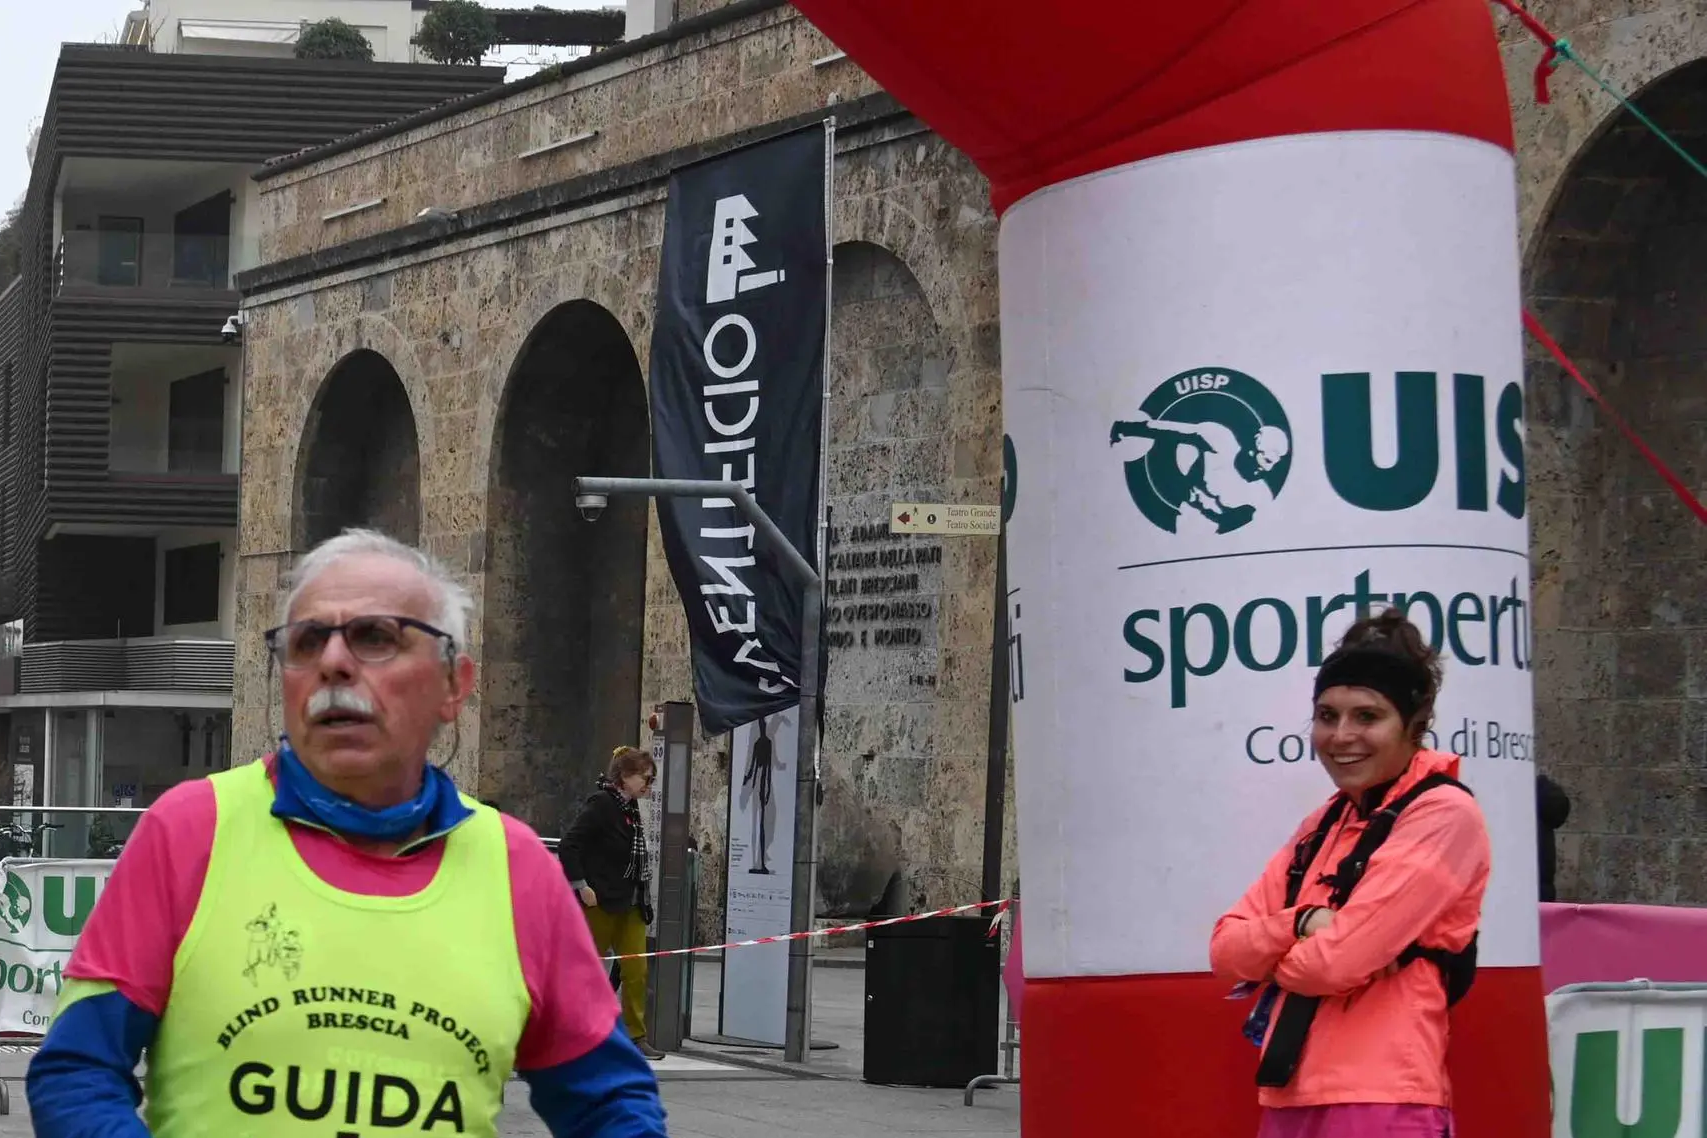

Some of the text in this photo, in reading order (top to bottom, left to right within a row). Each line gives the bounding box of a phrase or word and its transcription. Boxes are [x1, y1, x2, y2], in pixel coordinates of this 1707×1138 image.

[1173, 374, 1230, 395] UISP
[945, 519, 998, 530] Teatro Sociale
[946, 507, 997, 518] Teatro Grande
[1451, 717, 1478, 758] di
[217, 996, 280, 1050] BLIND
[292, 986, 397, 1010] RUNNER
[409, 1001, 492, 1075] PROJECT
[306, 1012, 410, 1040] BRESCIA
[229, 1061, 465, 1133] GUIDA
